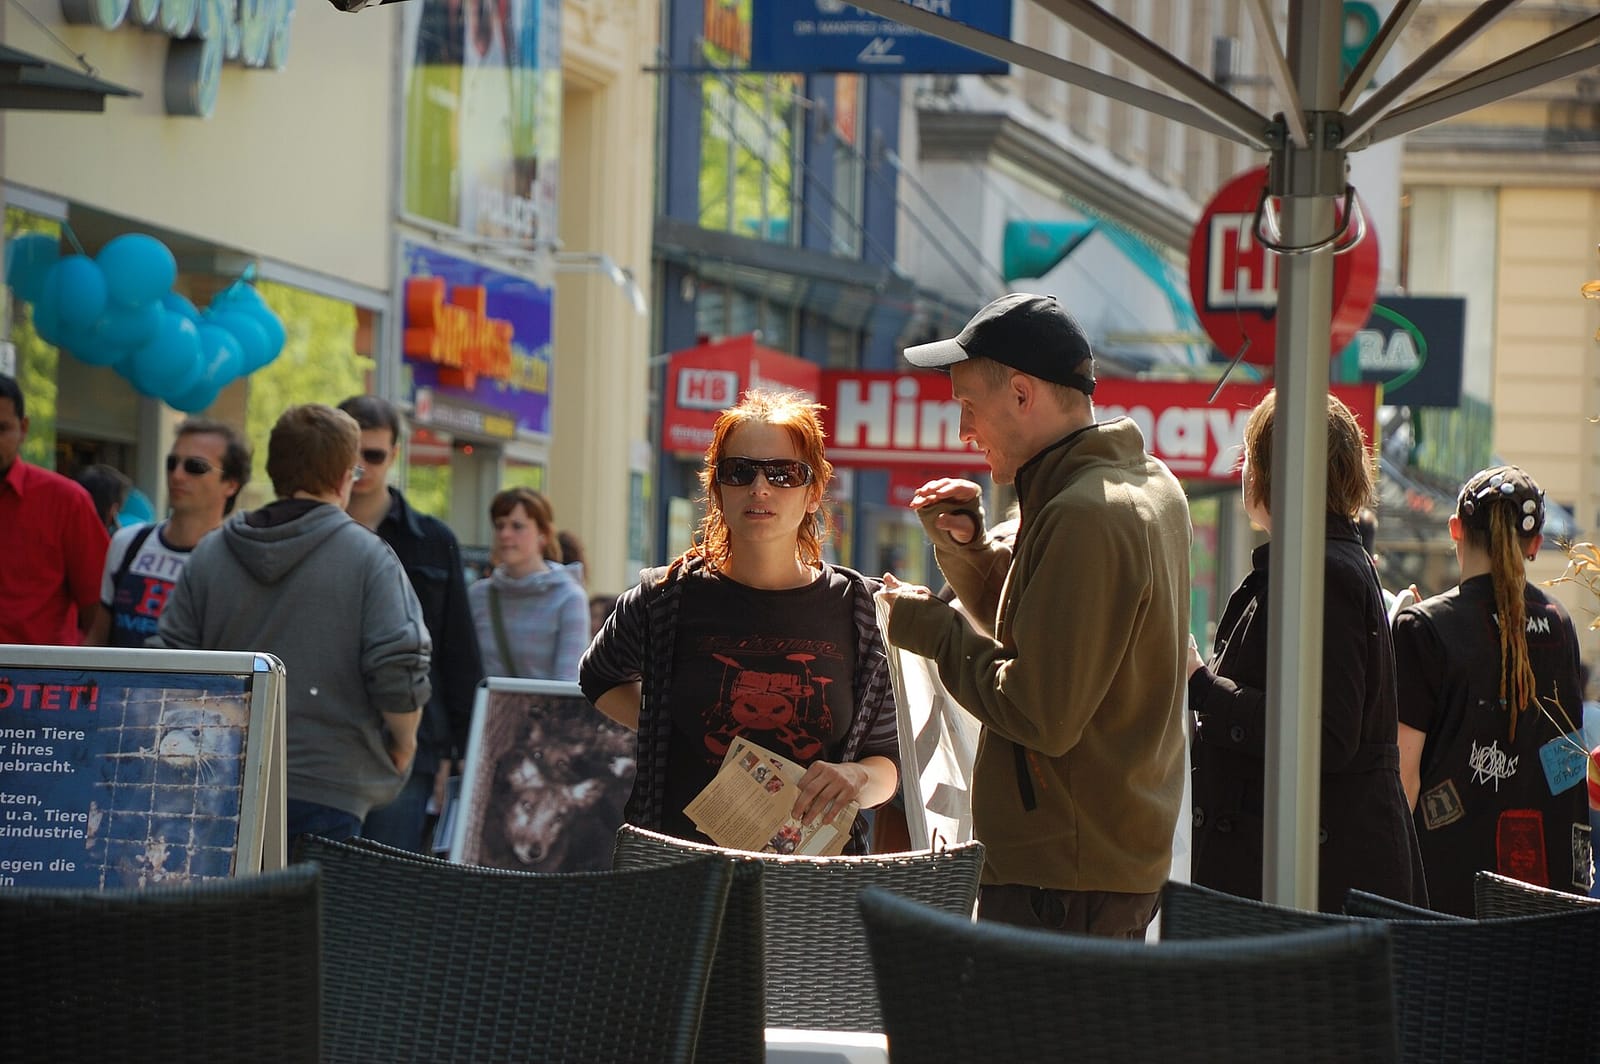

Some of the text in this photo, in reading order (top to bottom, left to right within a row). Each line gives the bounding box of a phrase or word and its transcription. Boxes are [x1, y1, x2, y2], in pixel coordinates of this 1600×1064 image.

[1356, 330, 1421, 370] RA
[835, 376, 972, 448] Hin
[41, 727, 86, 740] Tiere
[11, 742, 54, 756] ihres
[0, 791, 42, 807] tzen,
[6, 809, 88, 822] u.a. Tiere
[0, 859, 76, 873] egen die
